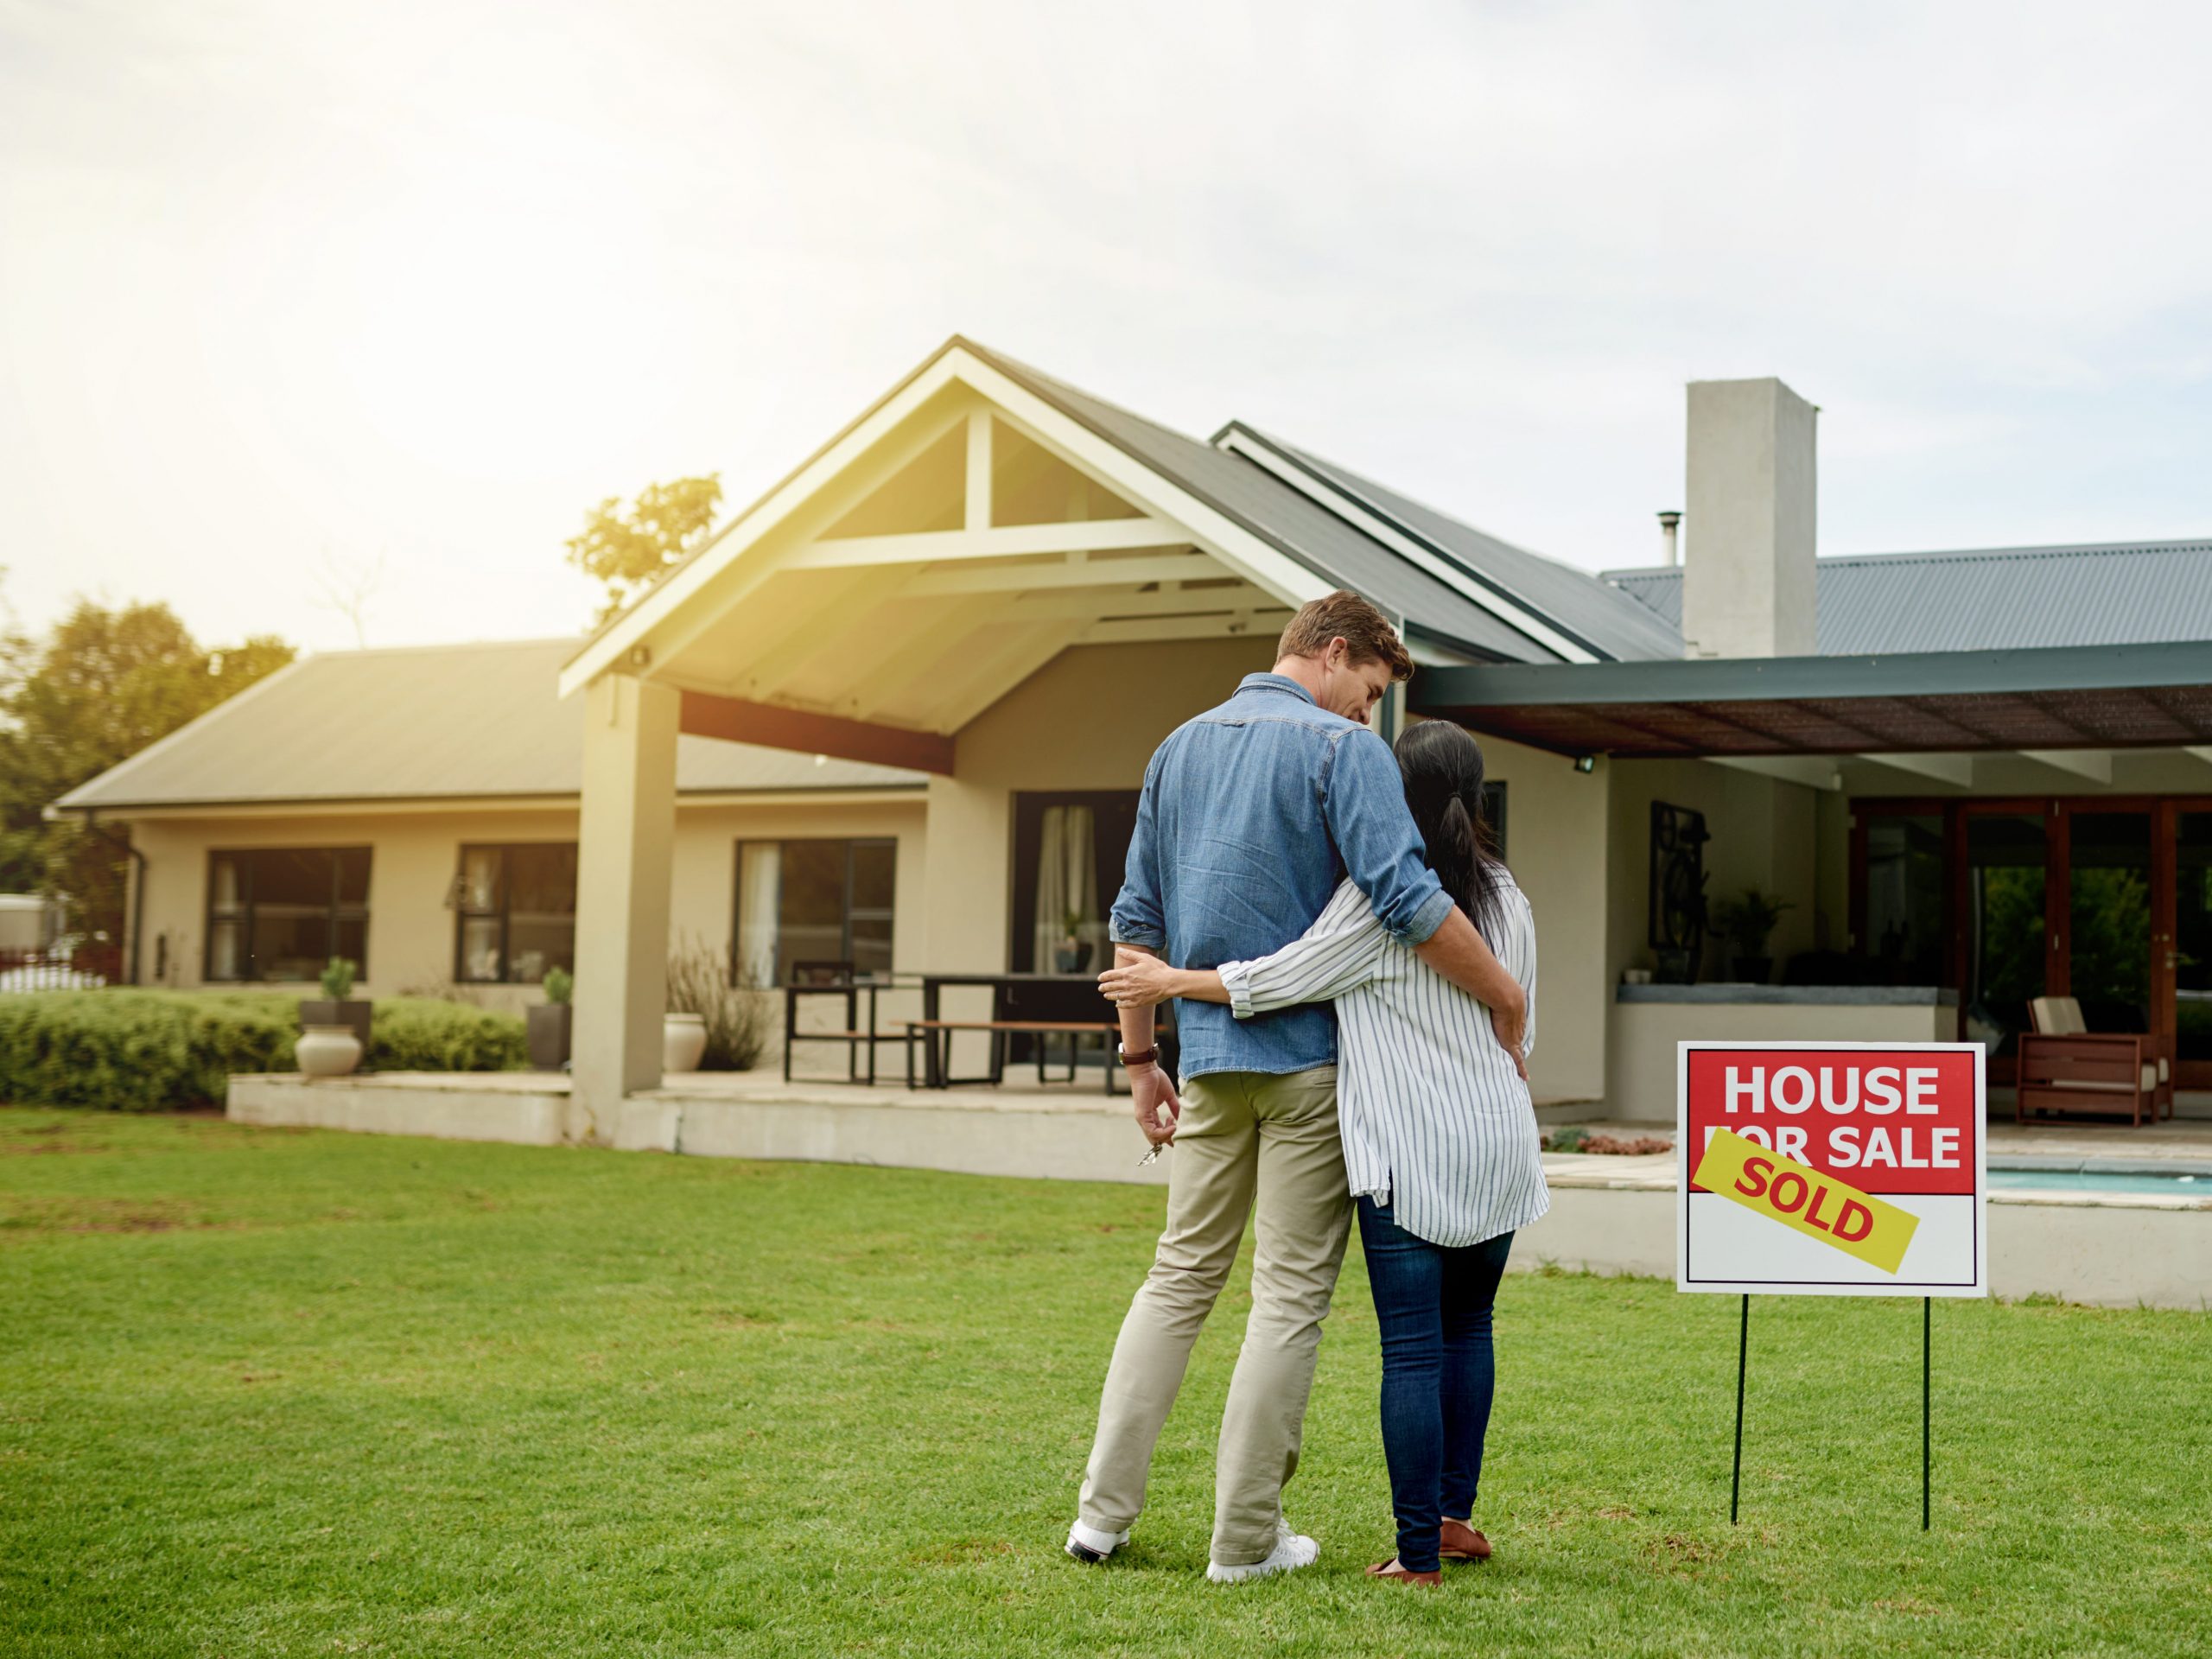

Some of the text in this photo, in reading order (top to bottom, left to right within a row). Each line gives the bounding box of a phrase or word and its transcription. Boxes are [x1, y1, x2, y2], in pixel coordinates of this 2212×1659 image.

[1726, 1066, 1939, 1115] HOUSE
[1828, 1127, 1961, 1168] SALE
[1733, 1157, 1873, 1243] SOLD
